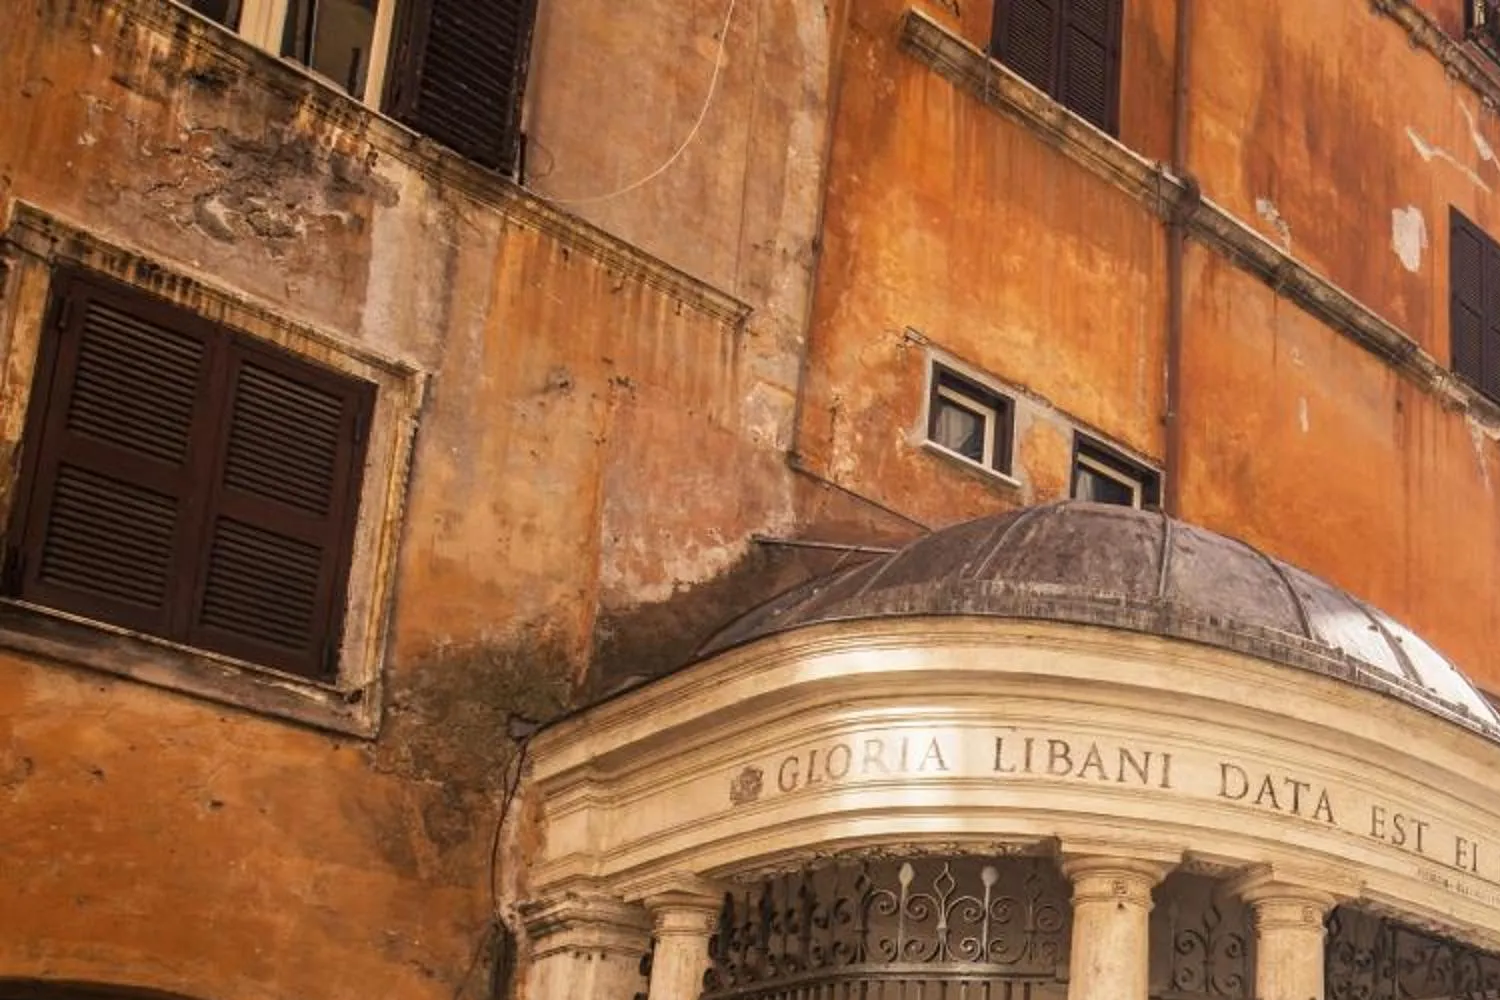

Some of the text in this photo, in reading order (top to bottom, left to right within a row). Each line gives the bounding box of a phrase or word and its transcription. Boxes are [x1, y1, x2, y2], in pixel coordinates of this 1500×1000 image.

[777, 735, 950, 793] GLORIA
[993, 735, 1176, 790] LIBANI
[1217, 761, 1337, 825] DATA
[1369, 804, 1430, 854] EST
[1454, 834, 1482, 873] EI
